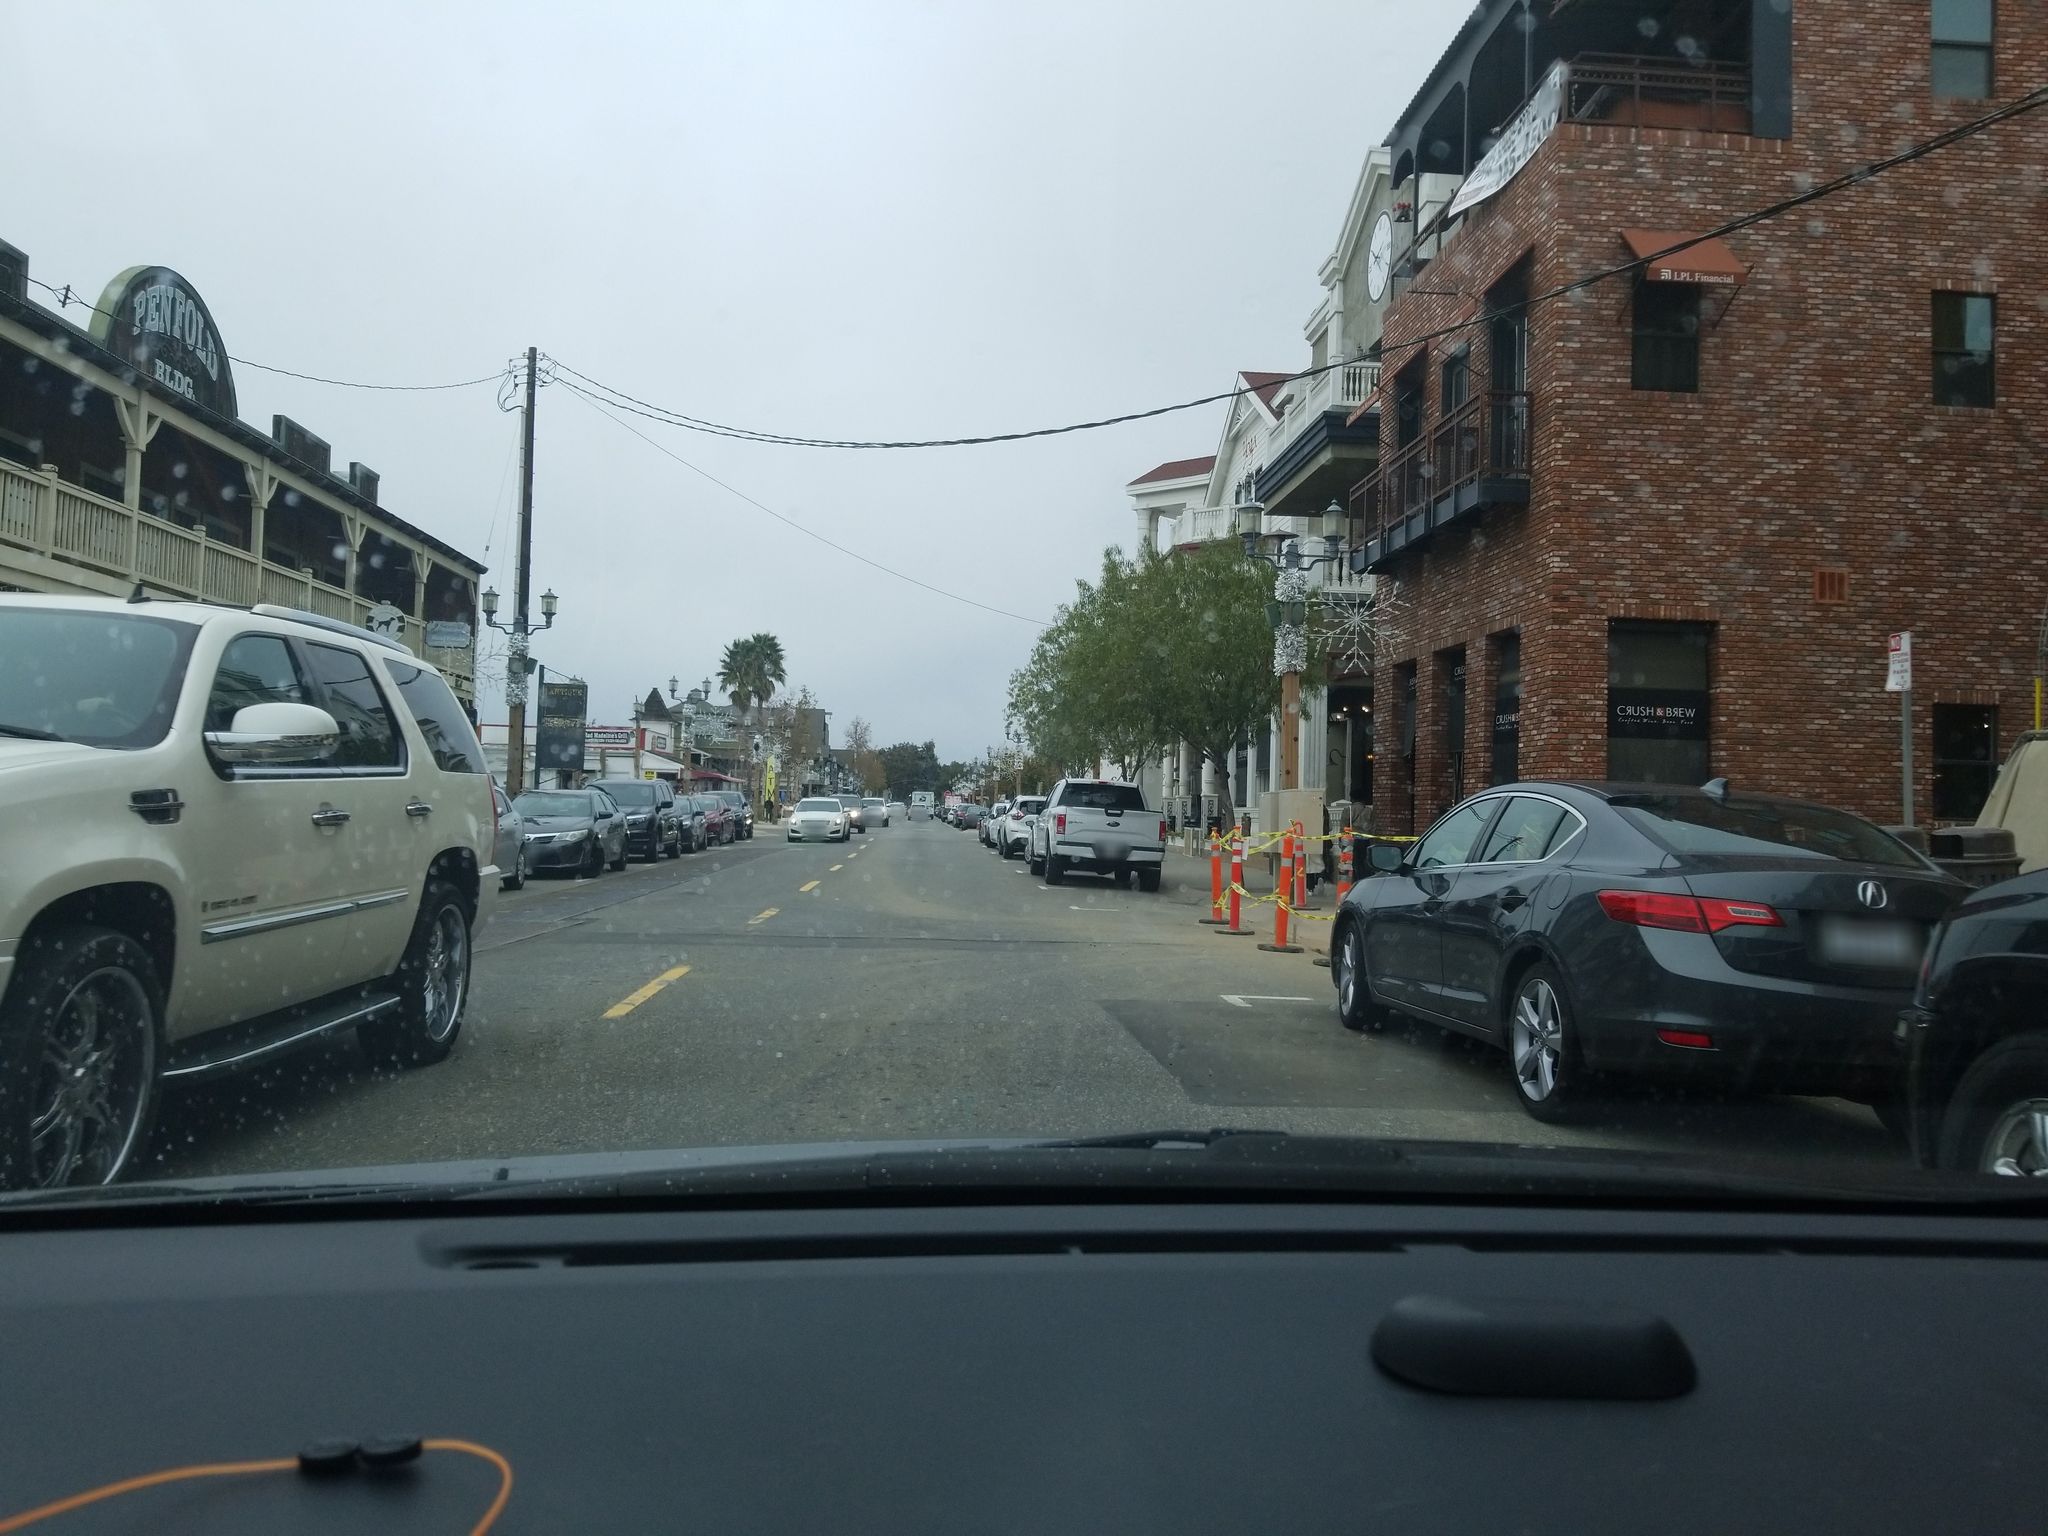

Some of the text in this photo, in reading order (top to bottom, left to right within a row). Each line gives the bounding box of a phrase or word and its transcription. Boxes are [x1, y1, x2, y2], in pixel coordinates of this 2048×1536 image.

[1673, 271, 1735, 284] LPL Financial
[133, 285, 218, 381] PENFOLD
[153, 358, 197, 401] BLDG.
[1616, 705, 1696, 718] CRUSH & BREW
[767, 765, 775, 798] ATM
